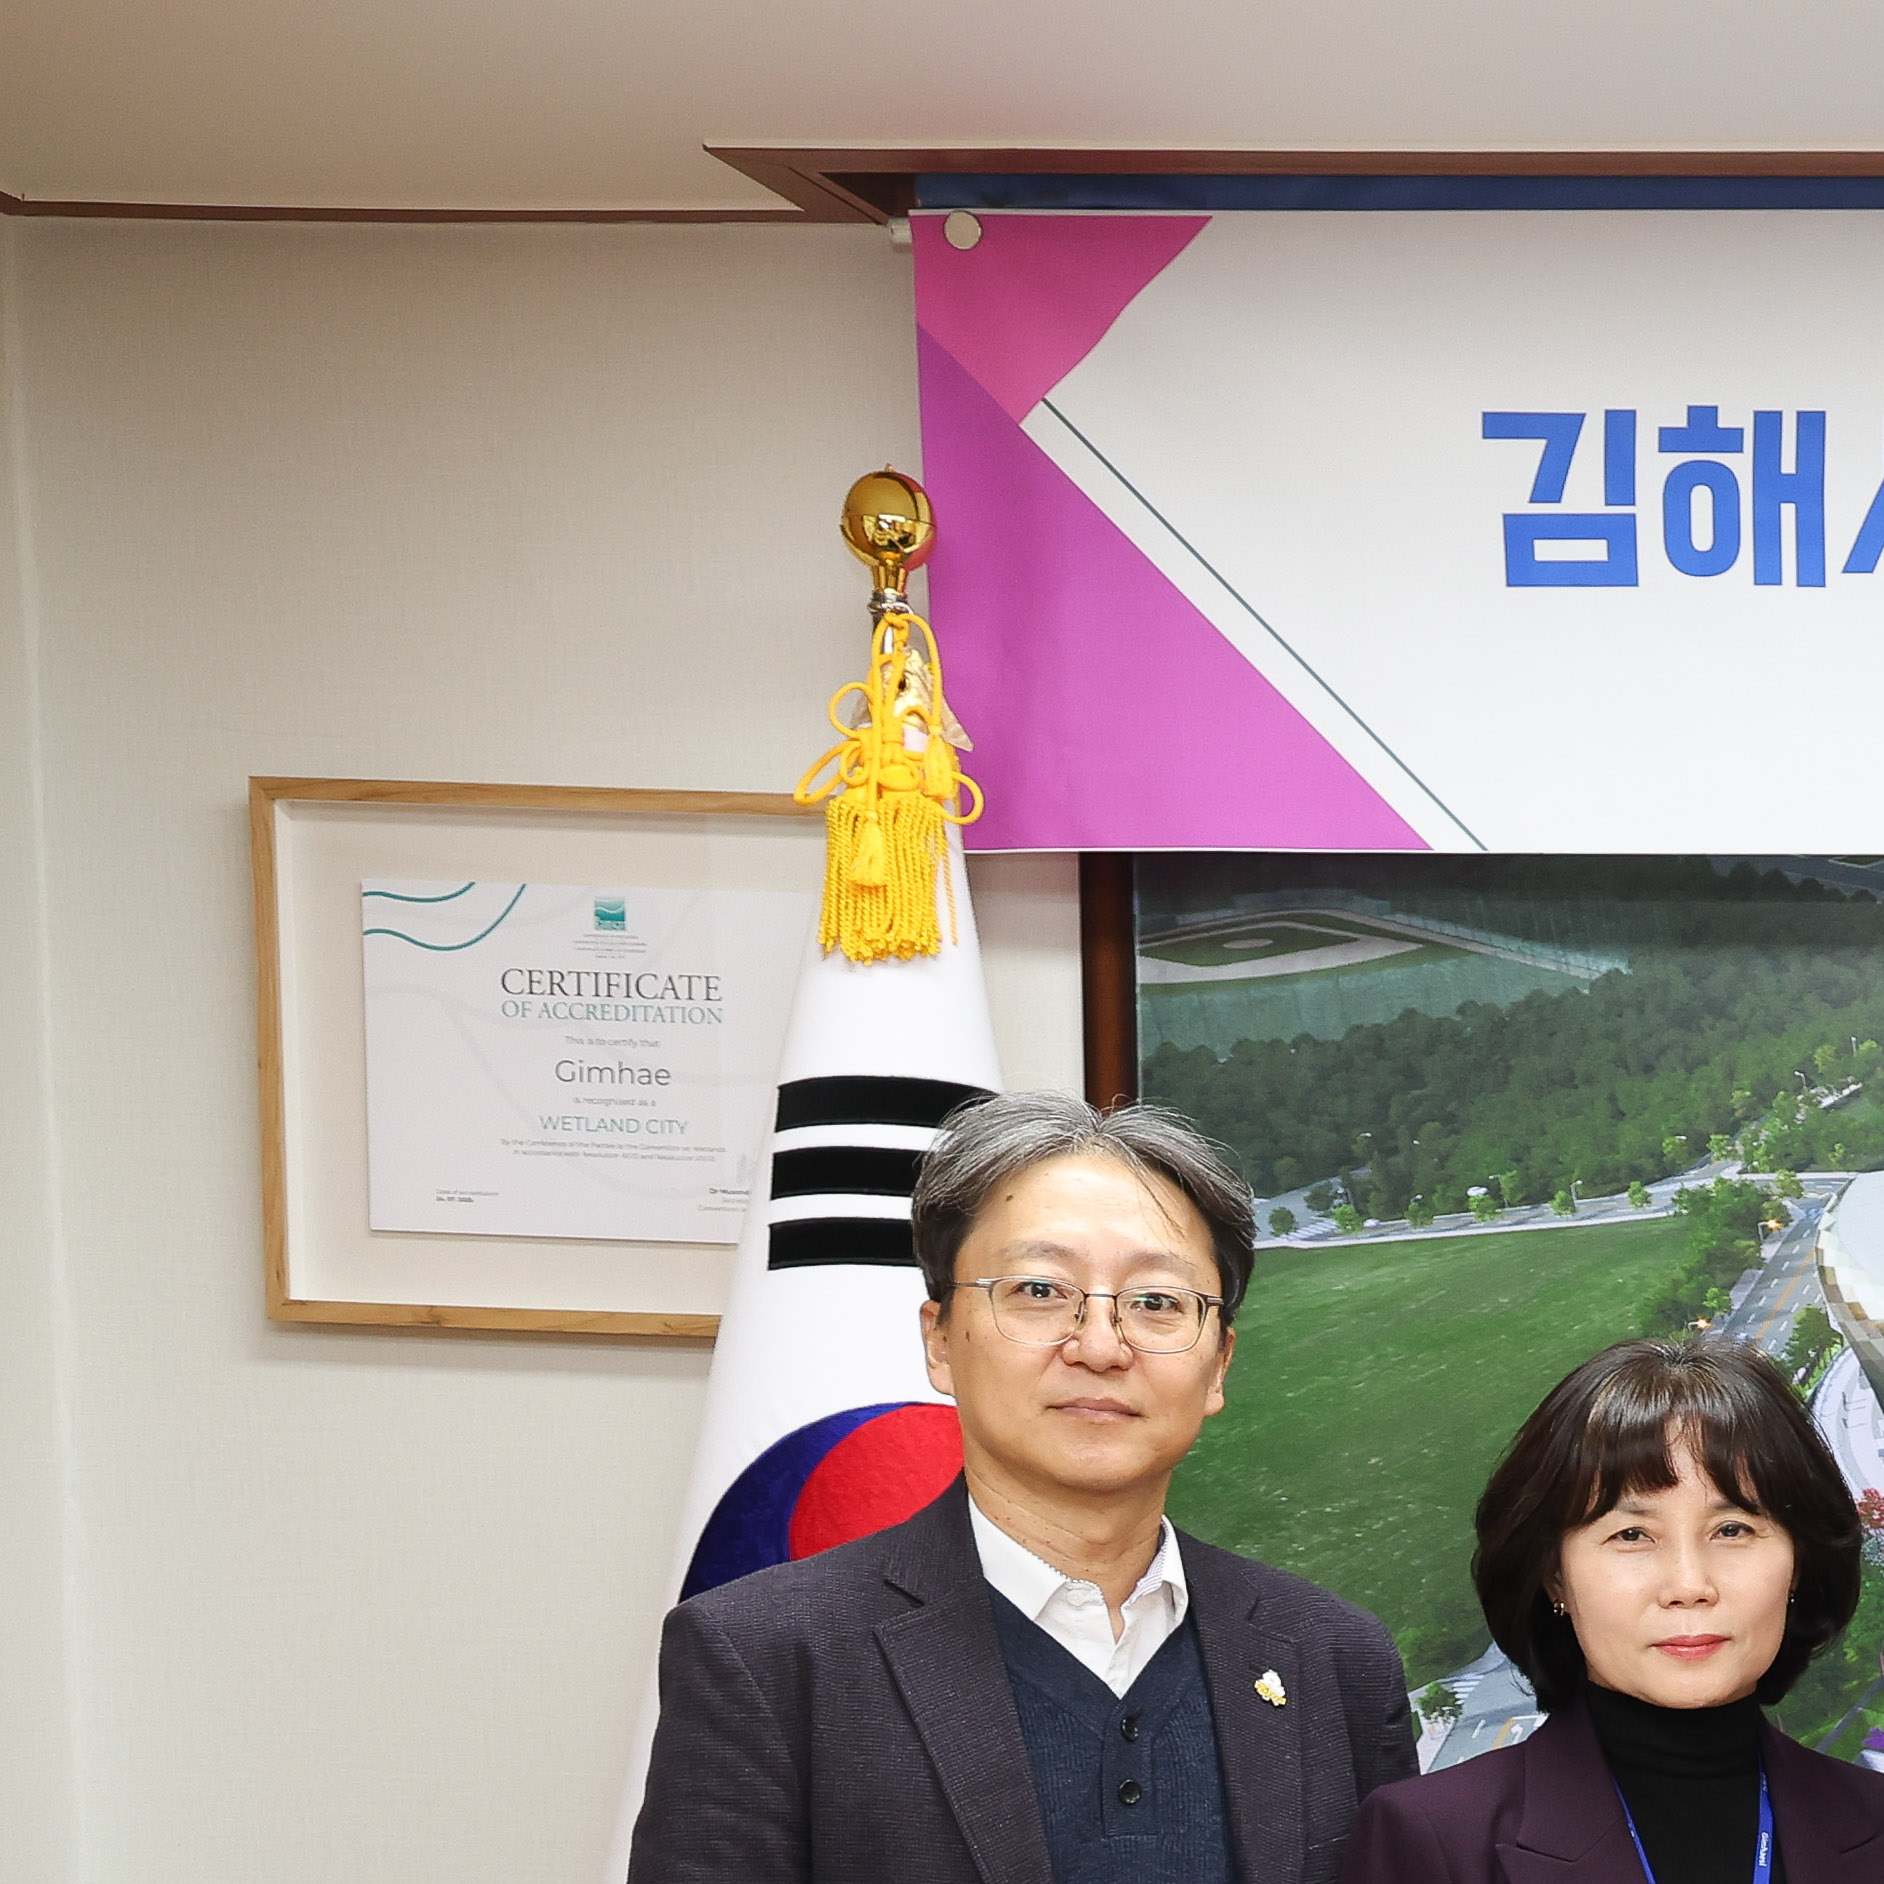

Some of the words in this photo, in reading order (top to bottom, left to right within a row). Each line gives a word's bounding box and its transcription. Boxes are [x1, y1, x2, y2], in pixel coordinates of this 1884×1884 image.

[501, 968, 722, 1001] CERTIFICATE
[501, 1000, 532, 1018] OF
[538, 1002, 723, 1025] ACCREDITATION
[555, 1060, 672, 1086] Gimhae
[539, 1115, 641, 1134] WETLAND
[646, 1119, 688, 1135] CITY
